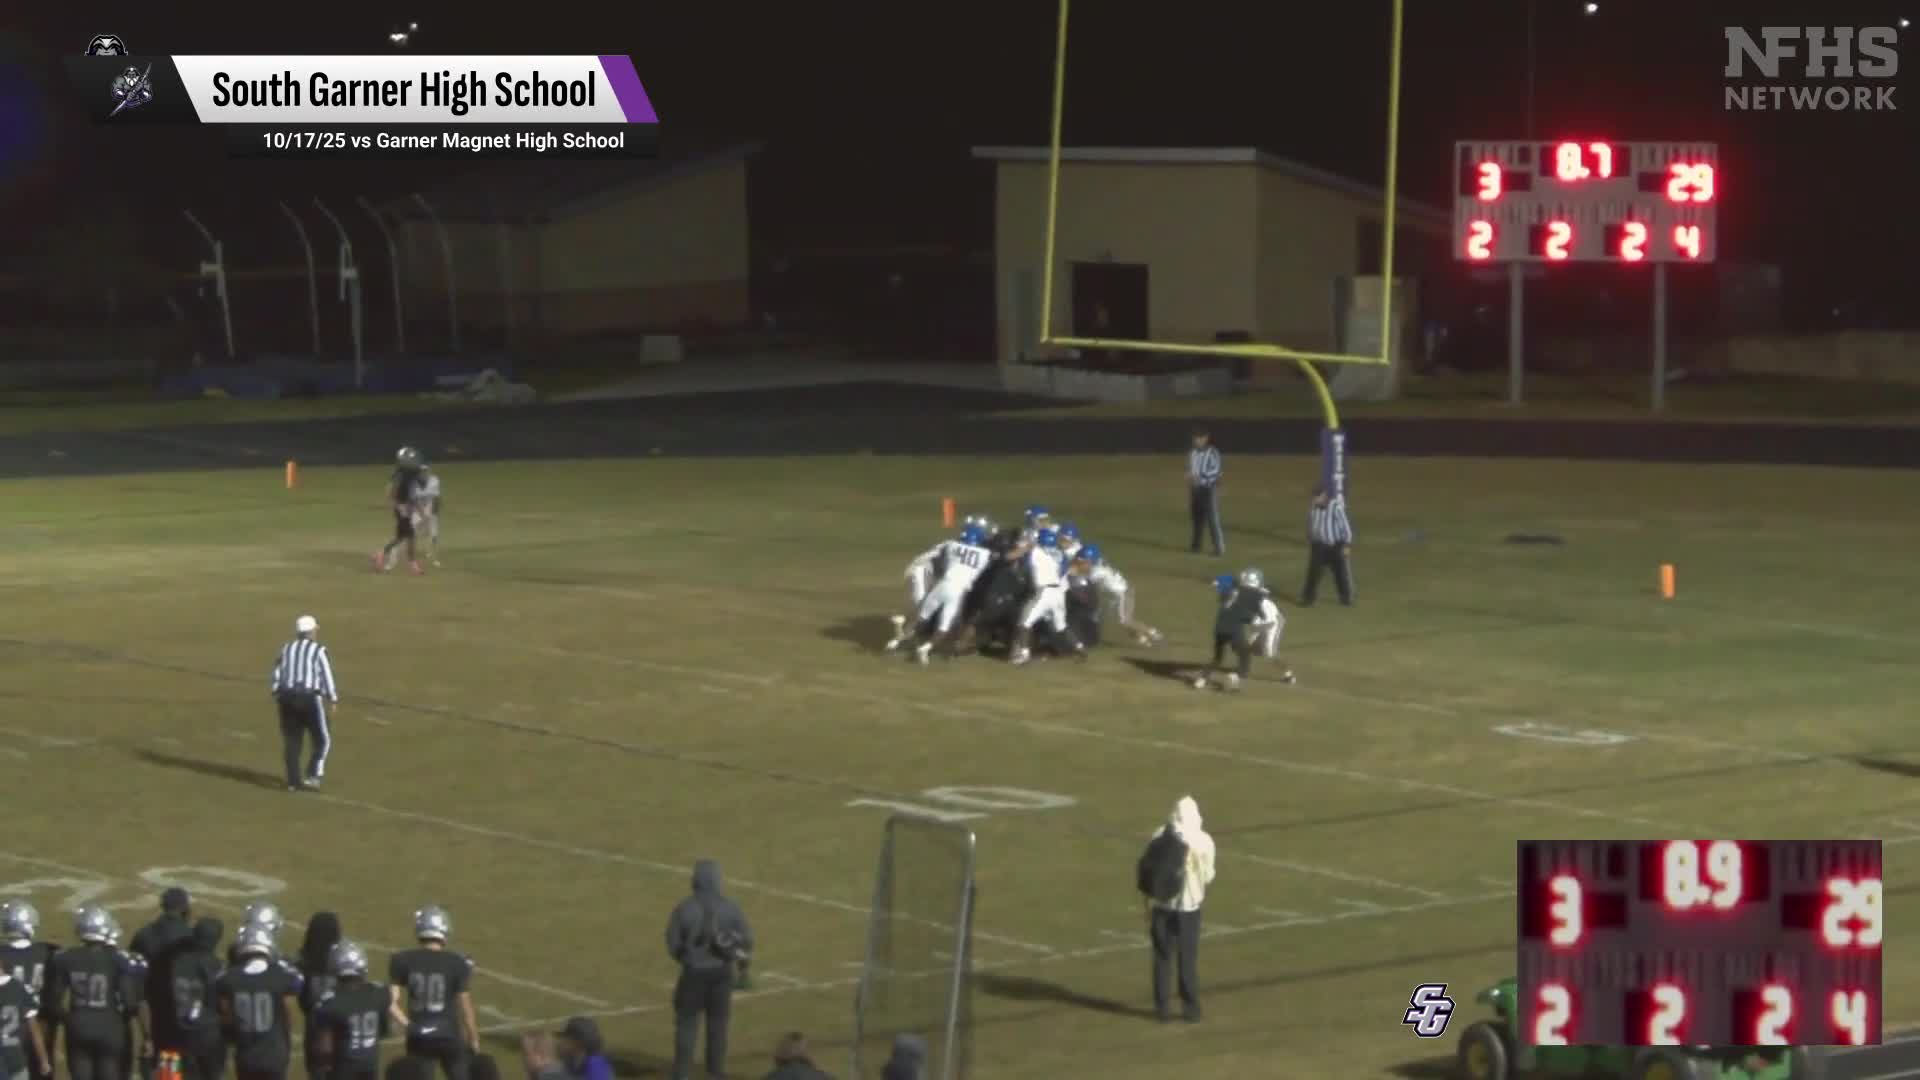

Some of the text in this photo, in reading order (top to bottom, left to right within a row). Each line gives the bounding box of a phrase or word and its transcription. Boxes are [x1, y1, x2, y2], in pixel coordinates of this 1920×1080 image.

[1556, 142, 1612, 181] 8.7
[1478, 162, 1502, 201] 3
[1667, 163, 1714, 202] 29
[1467, 220, 1493, 260] 2
[1546, 221, 1572, 260] 2
[1620, 222, 1648, 261] 2
[1674, 226, 1701, 259] 4
